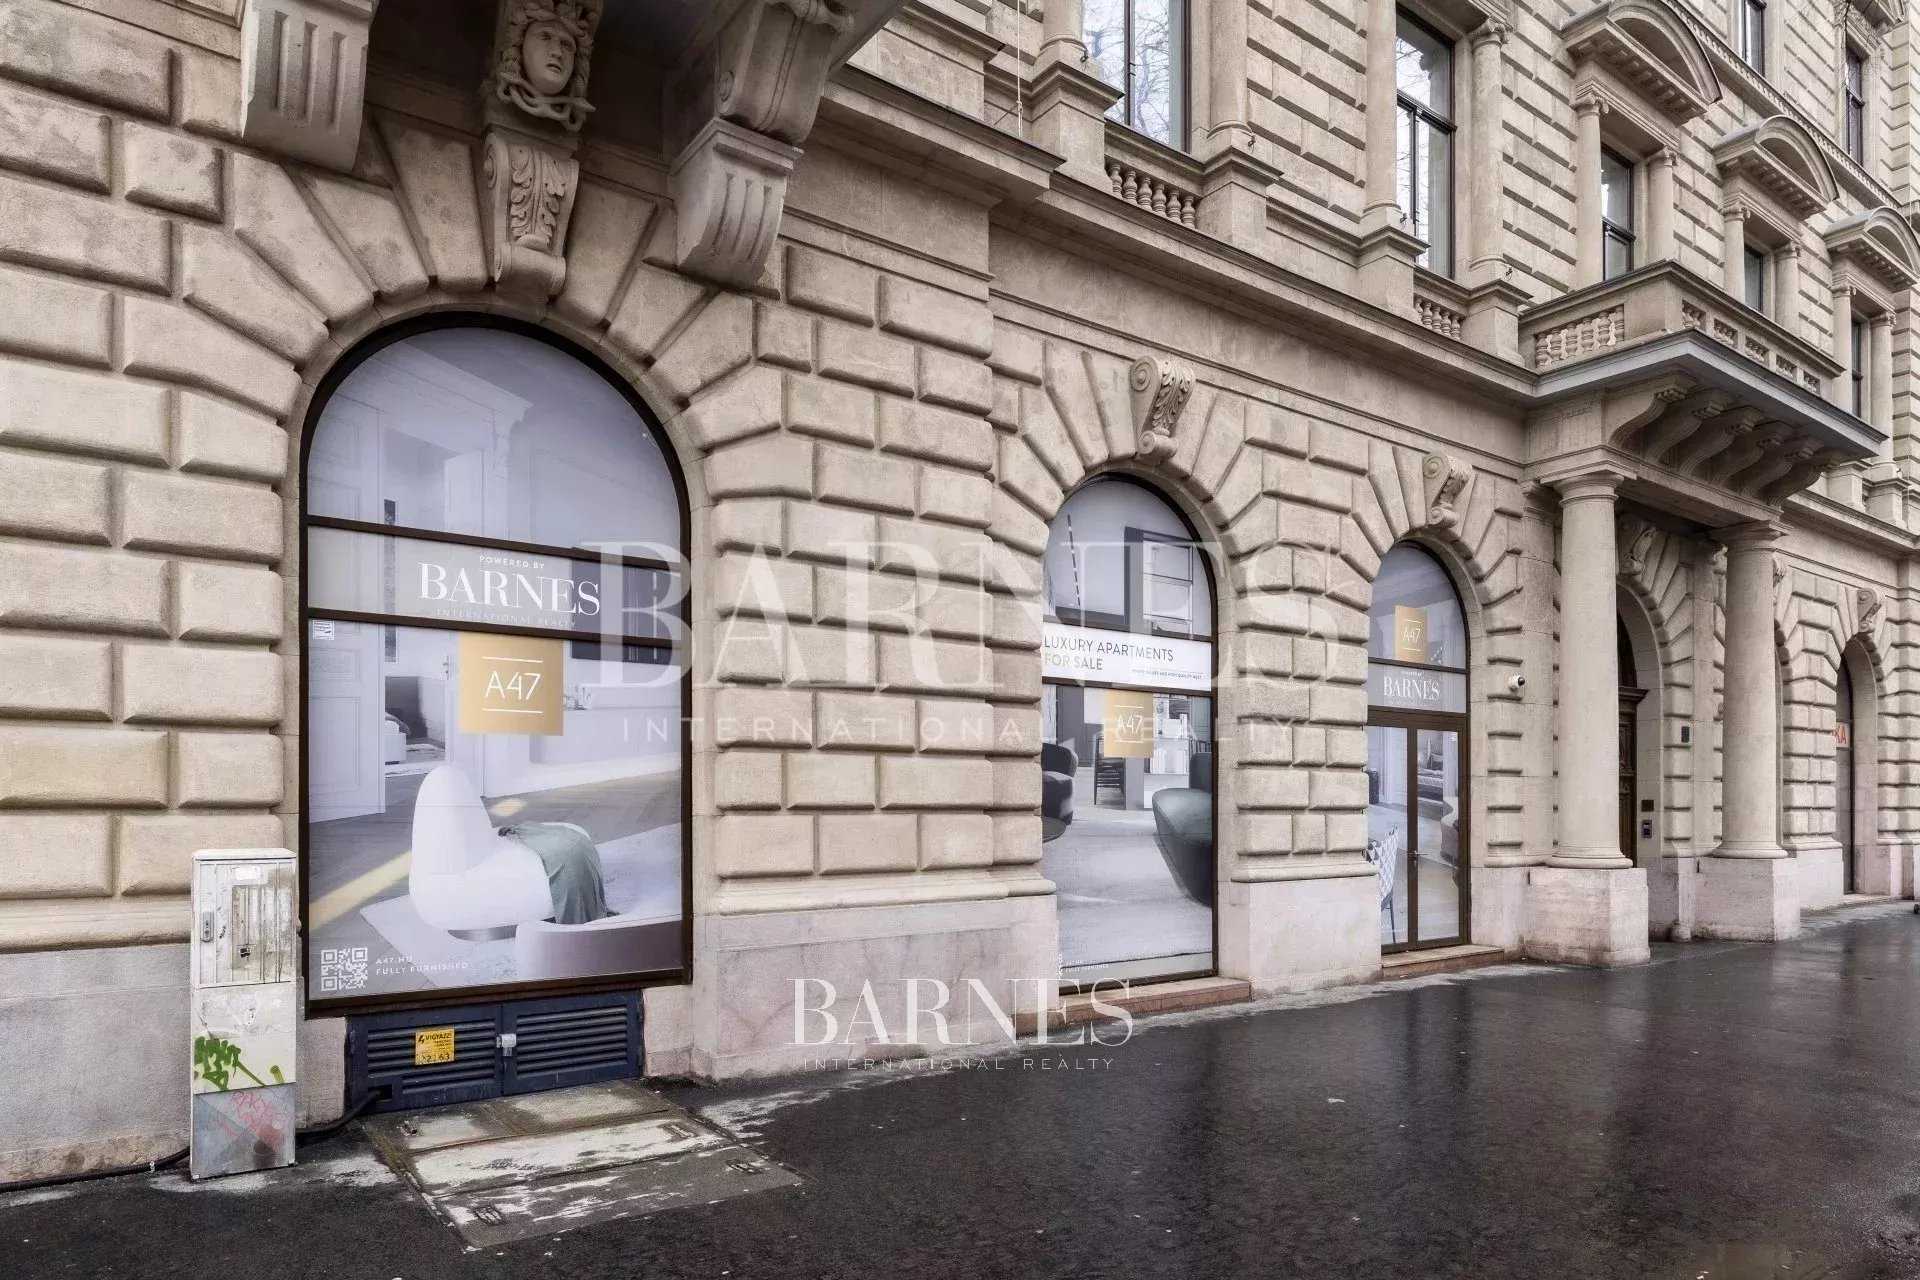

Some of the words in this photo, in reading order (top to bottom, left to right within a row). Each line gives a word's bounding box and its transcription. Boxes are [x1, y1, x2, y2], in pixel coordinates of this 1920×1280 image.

[479, 554, 529, 568] POWERED
[533, 561, 545, 569] BY
[418, 562, 600, 616] BARNES
[1044, 634, 1093, 652] LUXURY
[1097, 641, 1174, 662] APARTMENTS
[1044, 652, 1070, 668] FOR
[1074, 655, 1103, 671] SALE
[484, 670, 541, 702] A47
[1384, 676, 1440, 700] BARNES
[1117, 713, 1144, 735] A47
[376, 966, 406, 976] FULLY
